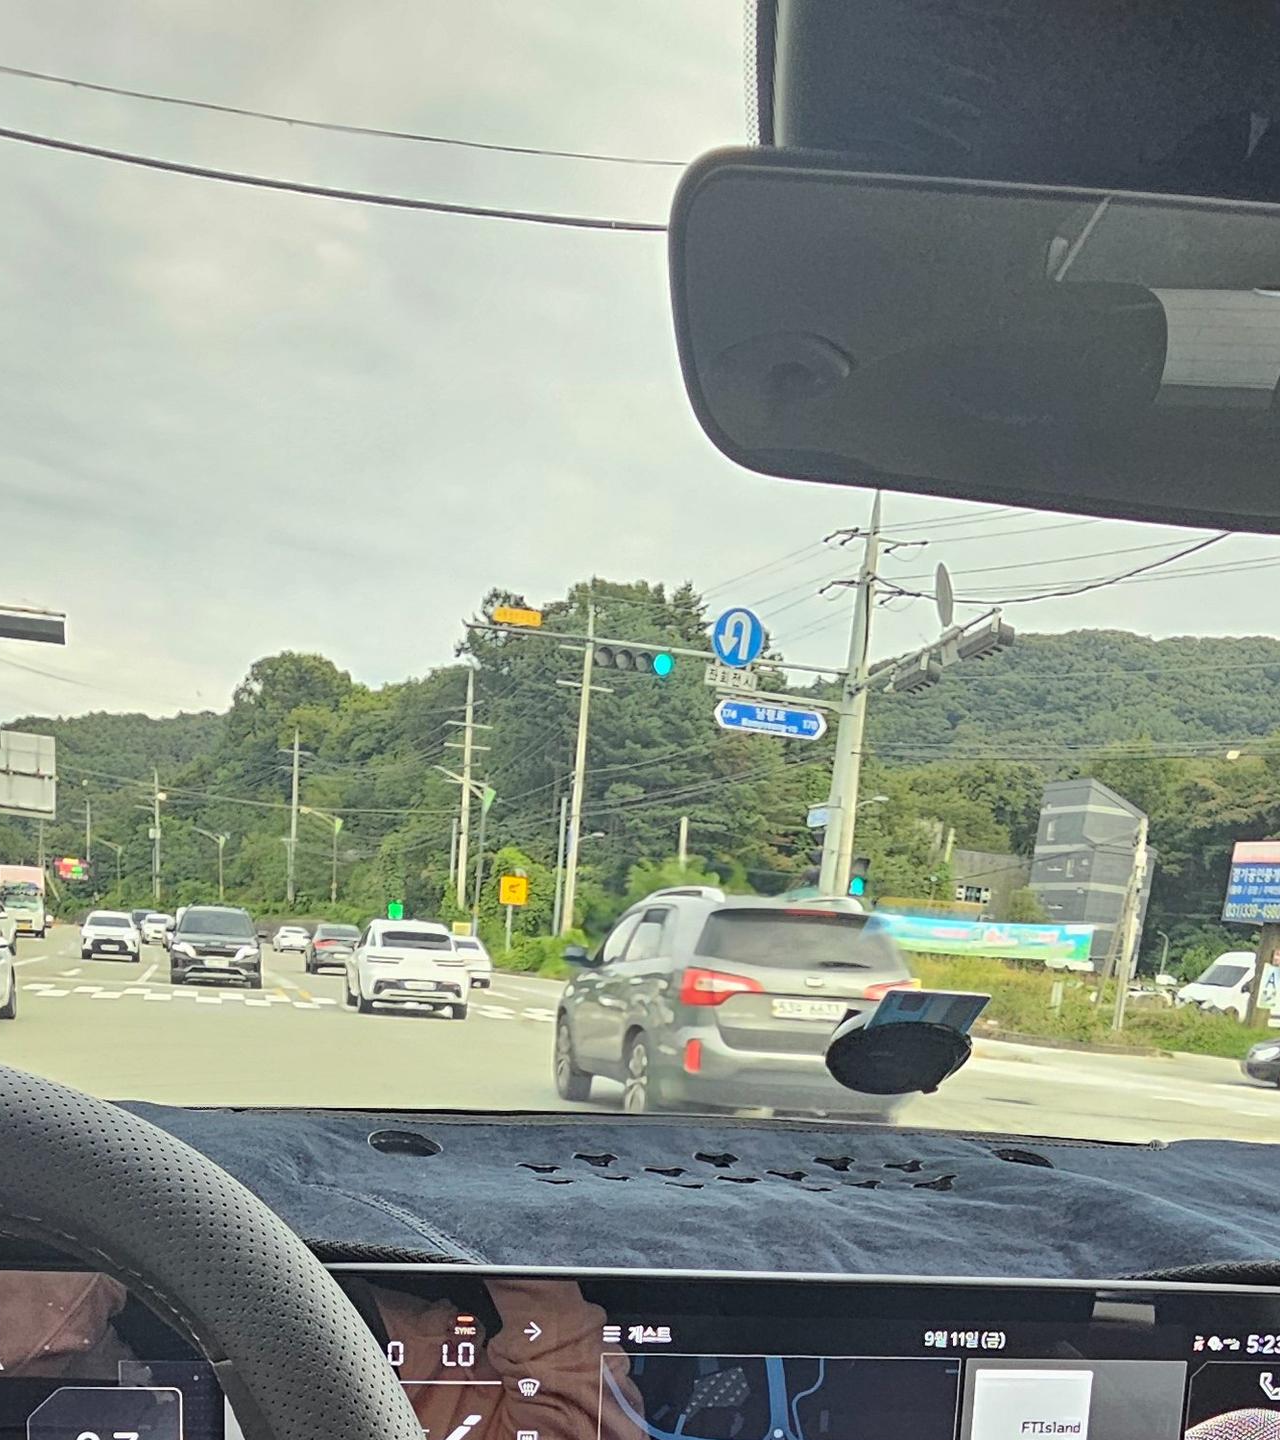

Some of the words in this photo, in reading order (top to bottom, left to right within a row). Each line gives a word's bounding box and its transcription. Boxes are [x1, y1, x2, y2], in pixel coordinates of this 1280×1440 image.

[454, 1326, 477, 1335] SYNC
[627, 1324, 672, 1344] 게스트
[923, 1331, 948, 1348] 9월
[950, 1331, 979, 1348] 11일
[980, 1331, 1006, 1349] (금)
[1021, 1421, 1081, 1434] FTIsland
